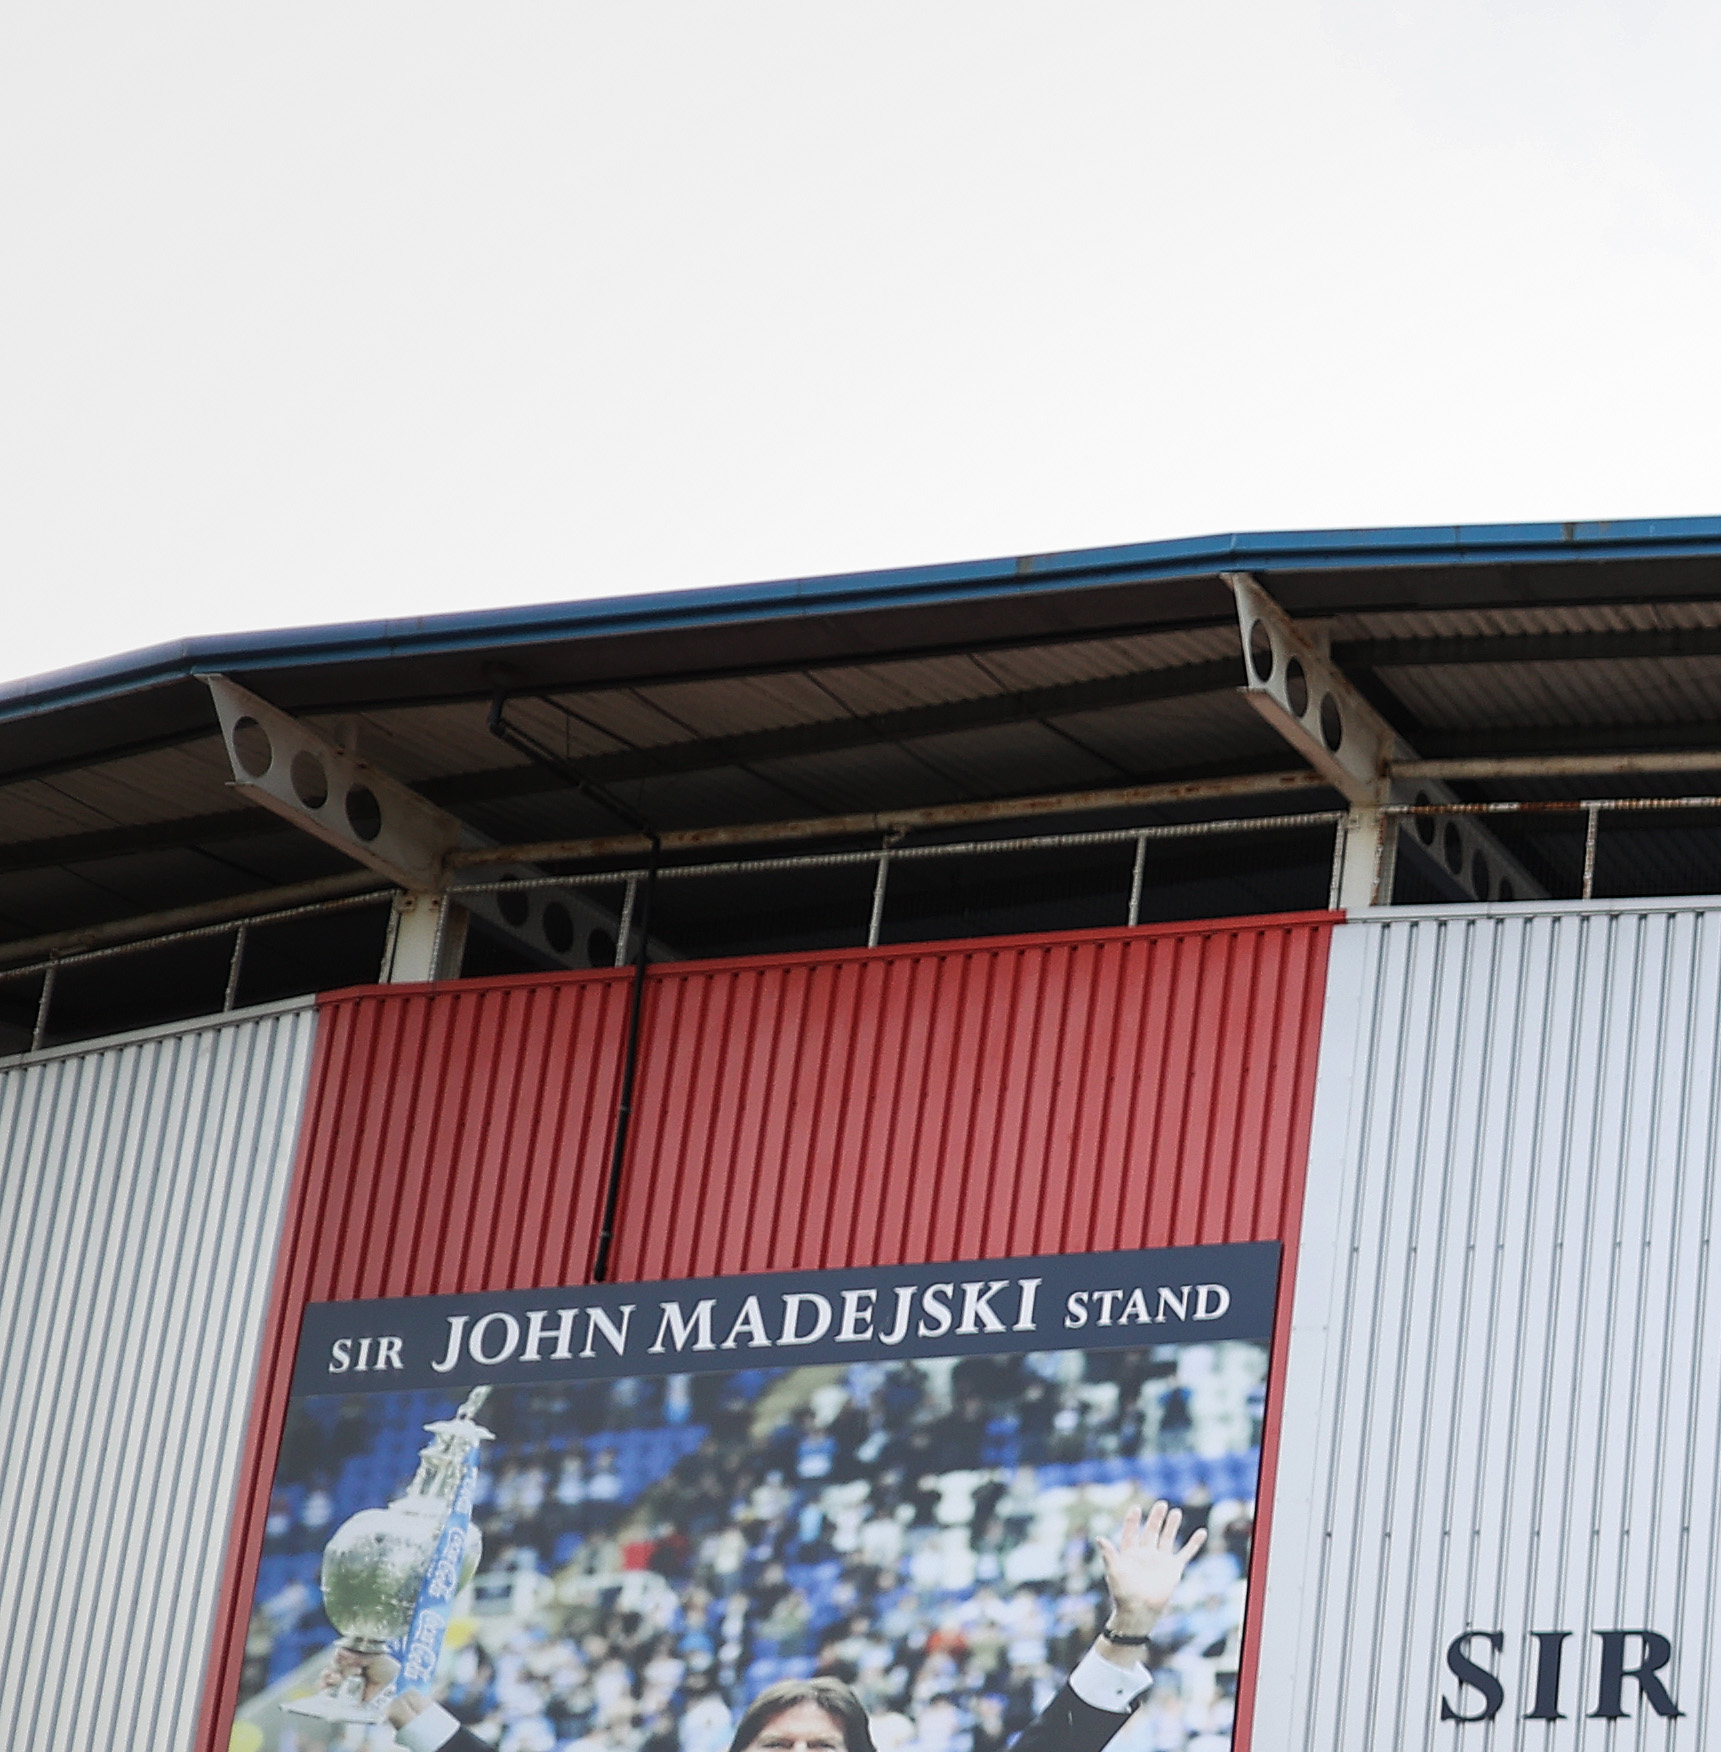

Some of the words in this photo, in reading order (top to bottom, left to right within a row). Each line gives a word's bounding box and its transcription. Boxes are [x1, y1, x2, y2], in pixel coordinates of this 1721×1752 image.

[328, 1336, 403, 1373] SIR
[432, 1304, 636, 1373] JOHN
[649, 1278, 1042, 1354] MADEJSKI
[1064, 1284, 1230, 1329] STAND
[1440, 1629, 1686, 1728] SIR
